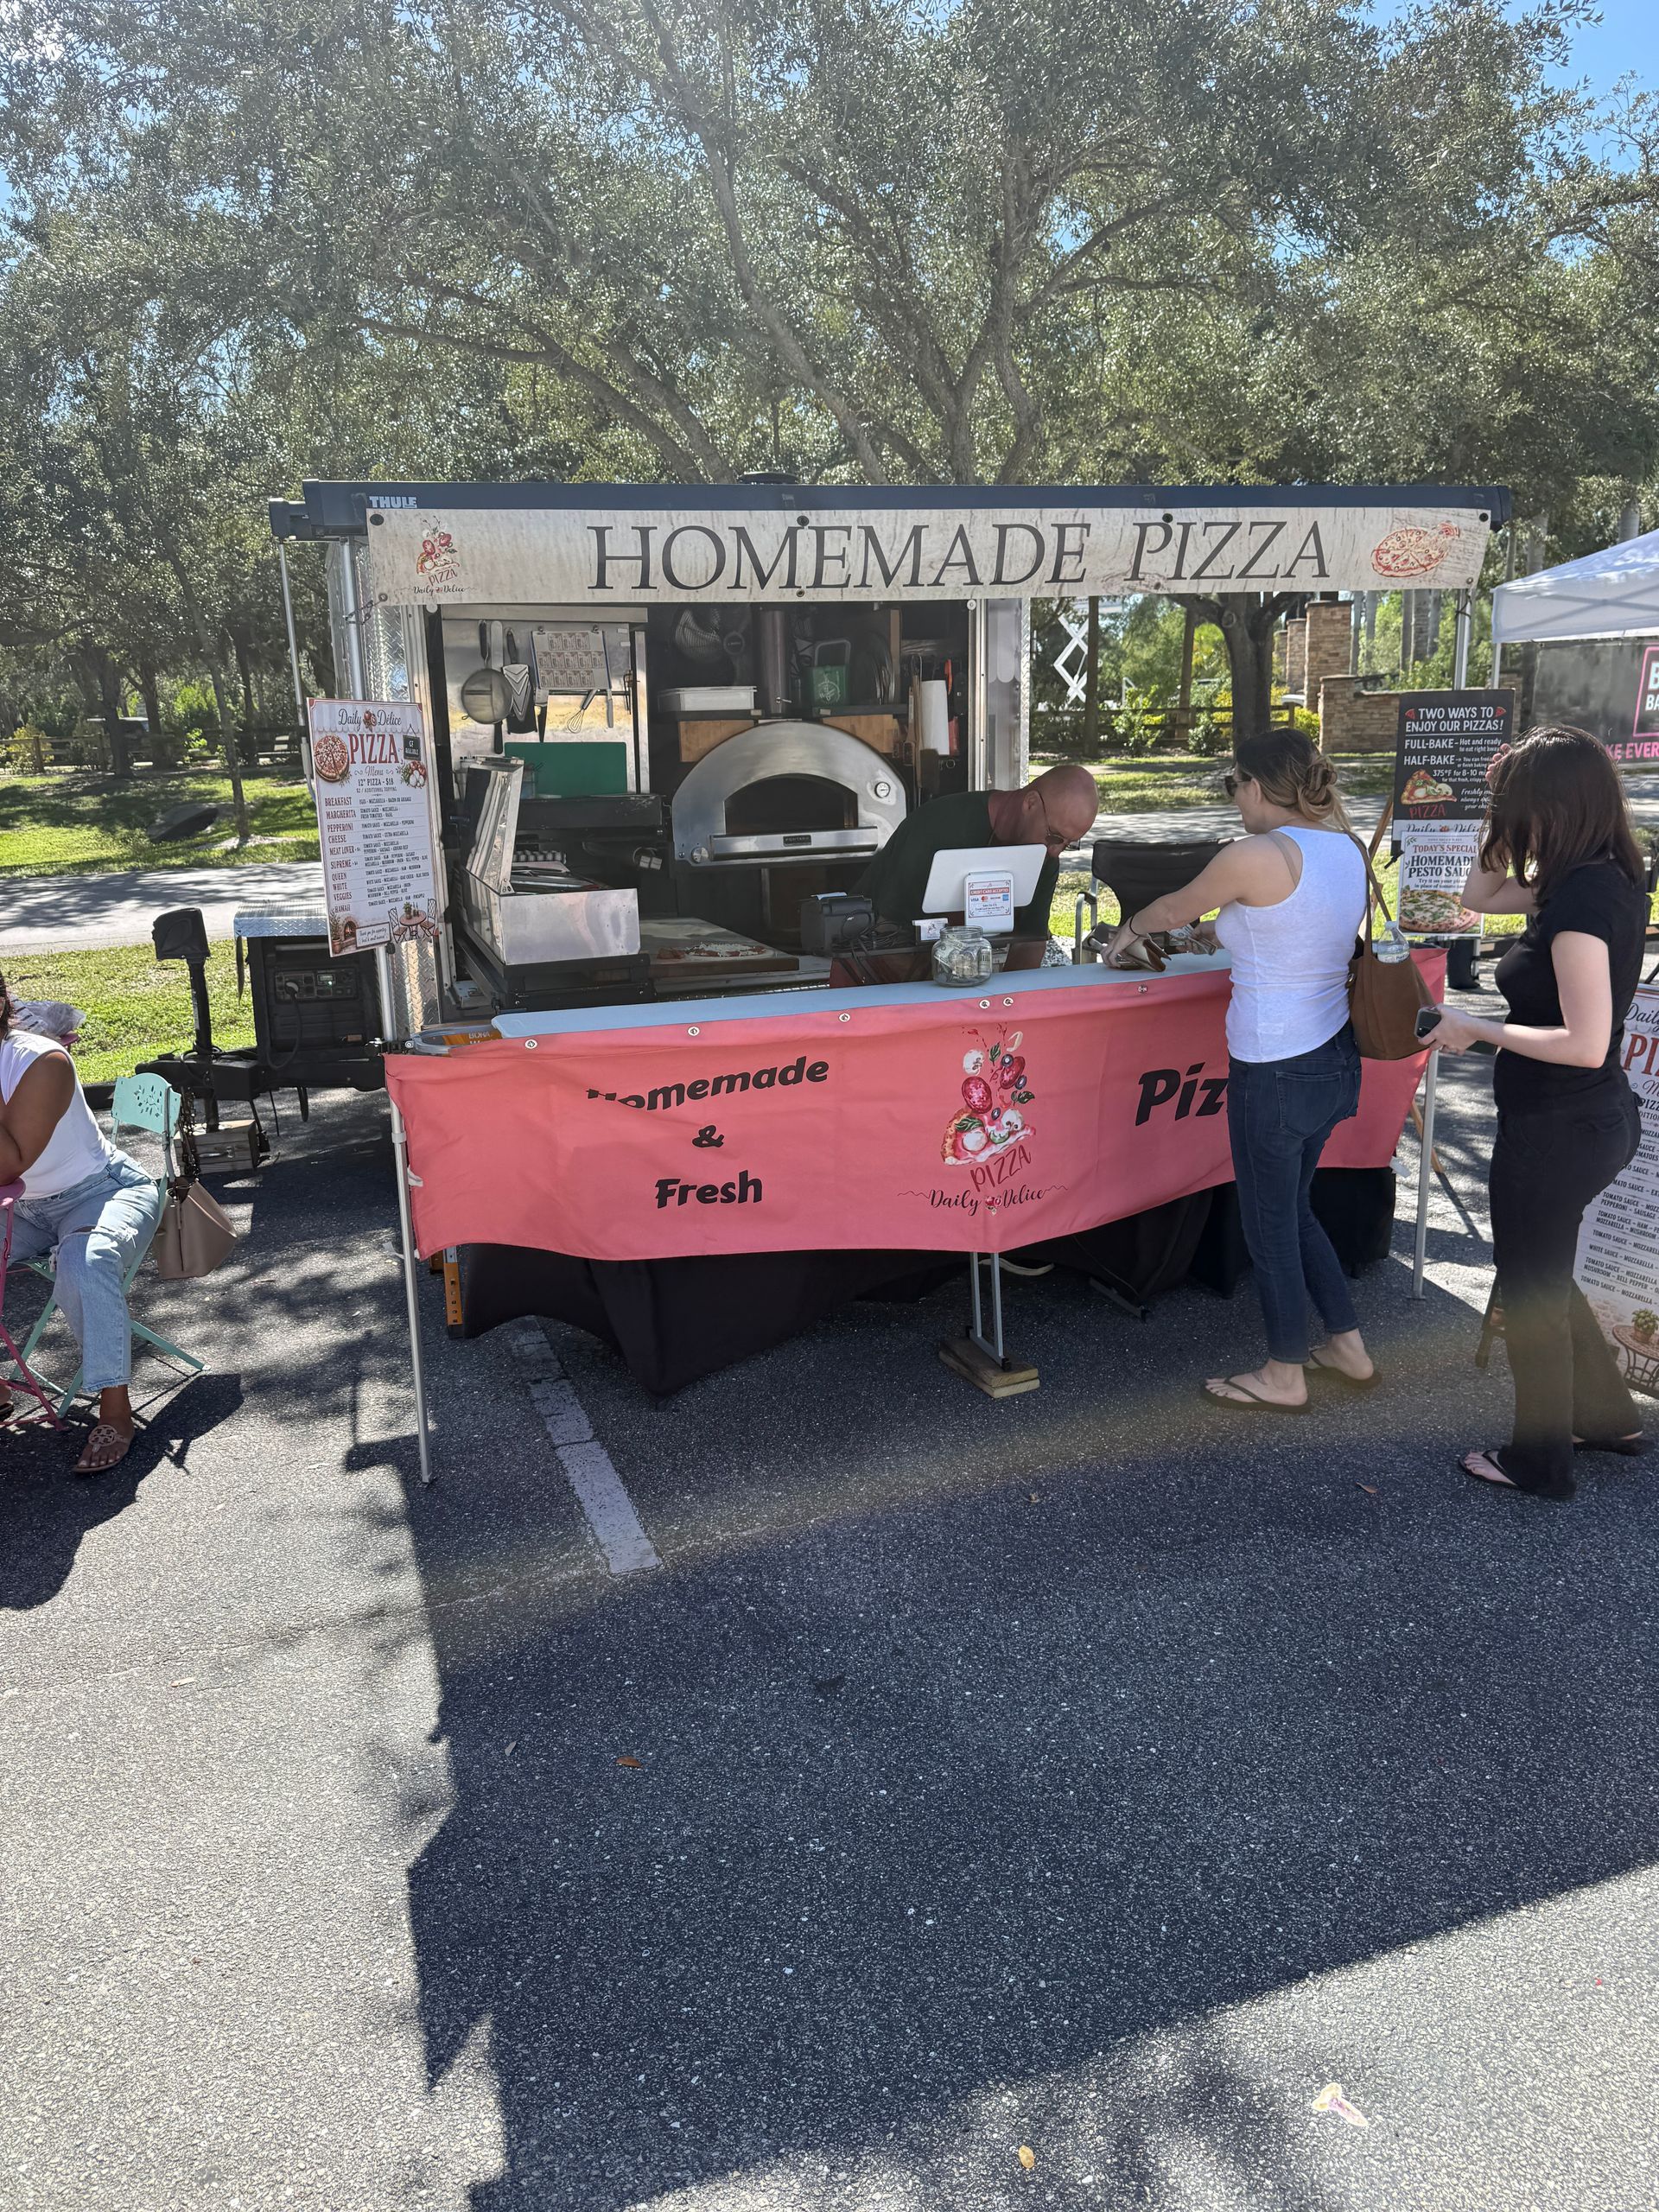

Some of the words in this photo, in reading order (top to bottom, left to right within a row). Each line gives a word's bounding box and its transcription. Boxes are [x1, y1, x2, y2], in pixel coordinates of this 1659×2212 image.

[369, 496, 417, 508] THULE
[587, 521, 1090, 591] HOMEMADE
[1123, 520, 1330, 583] PIZZA
[429, 569, 458, 586] PIZZA
[414, 586, 434, 595] Daily
[338, 709, 362, 732] Daily
[1419, 708, 1445, 720] TWO
[1448, 708, 1477, 719] WAYS
[1481, 707, 1493, 718] TO
[1406, 721, 1438, 732] ENJOY
[1440, 721, 1460, 731] OUR
[1463, 720, 1503, 731] PIZZAS!
[348, 734, 399, 764] PIZZA
[1405, 739, 1454, 749] FULL-BAKE
[1404, 755, 1455, 765] HALF-BAKE
[365, 766, 384, 776] Menu
[325, 798, 352, 806] BREAKFAST
[327, 810, 356, 819] MARGHERITA
[1410, 804, 1446, 818] PIZZA
[327, 823, 353, 832] PEPPERONI
[331, 860, 351, 869] SUPREME
[332, 873, 346, 881] QUEEN
[1408, 867, 1442, 878] PESTO
[1622, 1033, 1659, 1077] PI
[692, 1125, 724, 1147] &
[1639, 1143, 1656, 1152] SAUCE
[970, 1145, 1032, 1192] PIZZA
[1633, 1166, 1649, 1174] SAUCE
[655, 1169, 762, 1209] Fresh
[1628, 1183, 1644, 1192] SAUCE
[930, 1189, 980, 1217] Daily
[1601, 1199, 1628, 1212] PEPPERONI
[1603, 1192, 1623, 1202] TOMATO
[1624, 1198, 1639, 1206] SAUCE
[1599, 1210, 1616, 1220] TOMATO
[1617, 1216, 1631, 1224] SAUCE
[1596, 1217, 1624, 1230] MOZZARELLA
[1630, 1227, 1656, 1239] MUSHROOM
[1592, 1230, 1611, 1240] TOMATO
[1612, 1236, 1627, 1245] SAUCE
[1589, 1244, 1603, 1253] WHITE
[1604, 1249, 1618, 1258] SAUCE
[1624, 1255, 1654, 1269] MOZZARELLA
[1584, 1264, 1611, 1277] MUSHROOM
[1629, 1278, 1649, 1289] PEPPER
[1586, 1256, 1605, 1268] TOMATO
[1605, 1263, 1619, 1273] SAUCE
[1626, 1269, 1657, 1285] MOZZARELLA
[1581, 1275, 1599, 1286] TOMATO
[1601, 1281, 1615, 1292] SAUCE
[1621, 1289, 1652, 1305] MOZZARELLA
